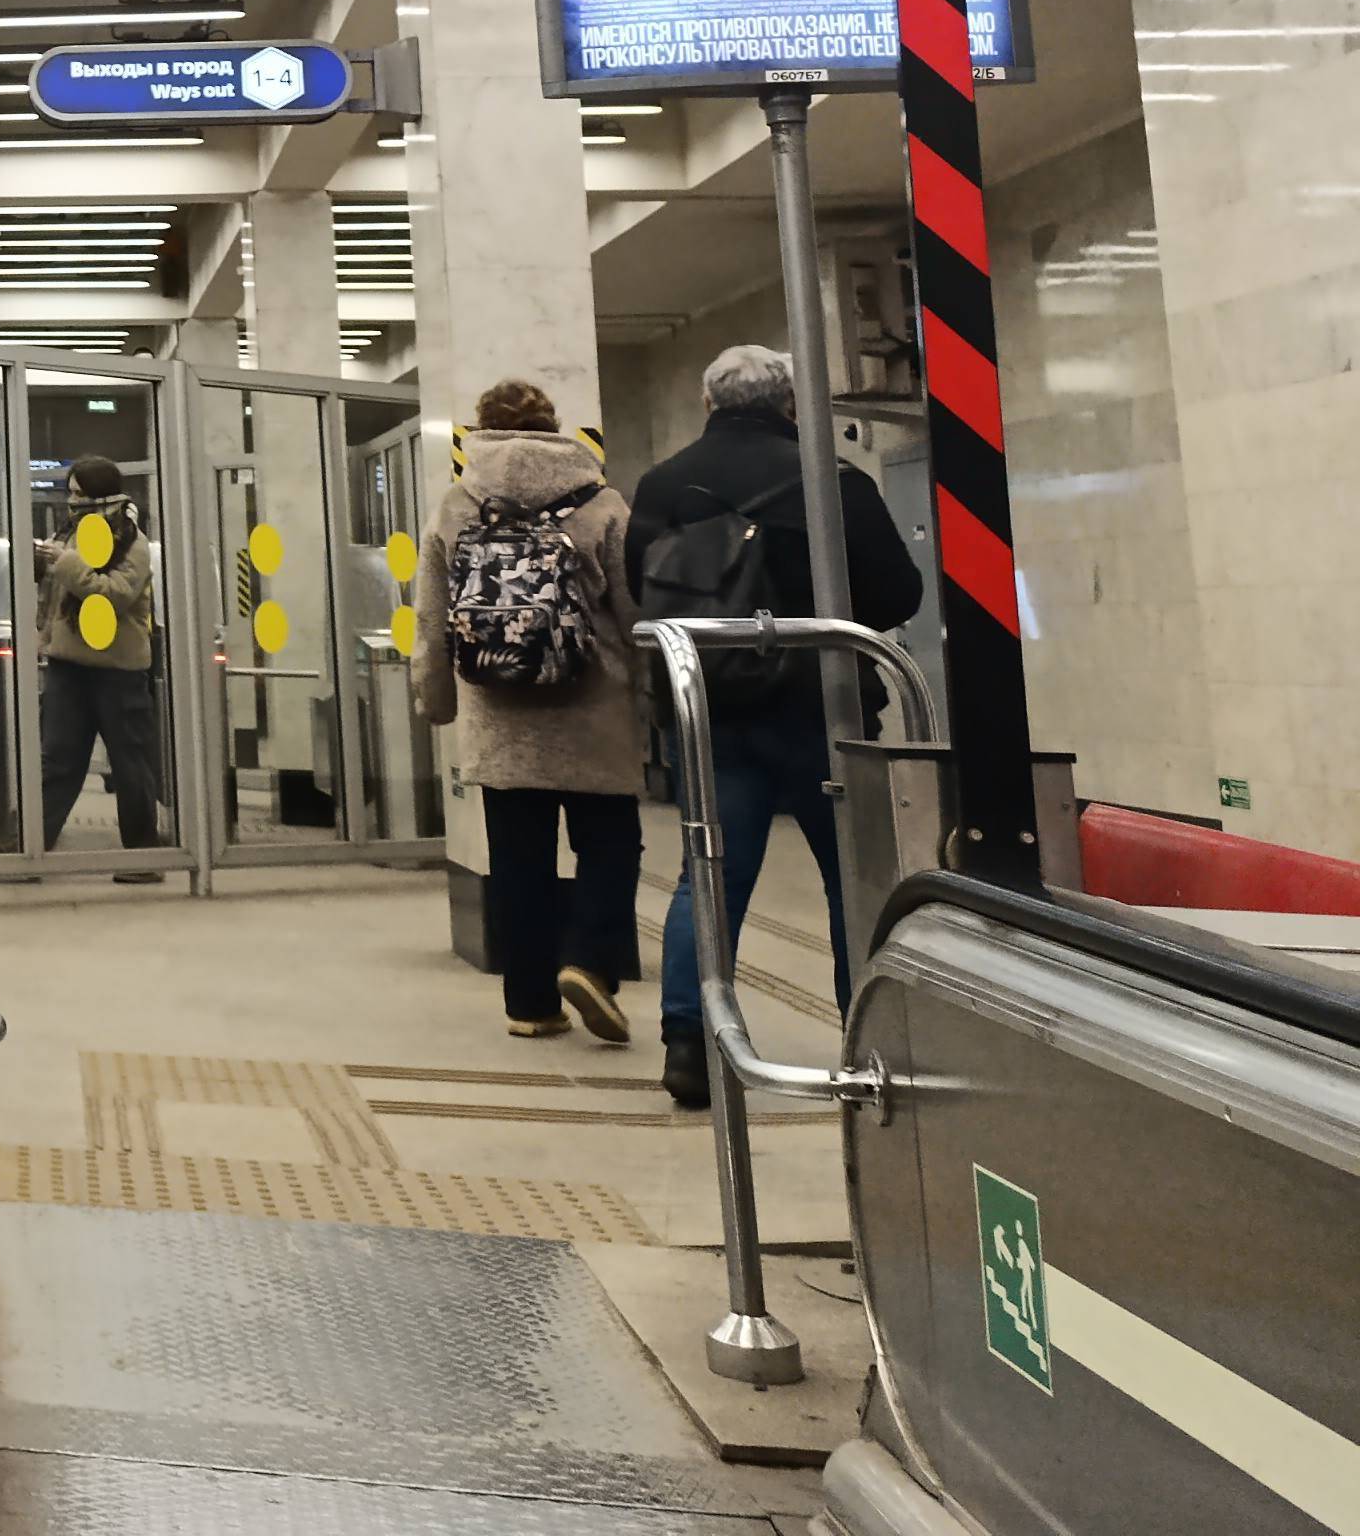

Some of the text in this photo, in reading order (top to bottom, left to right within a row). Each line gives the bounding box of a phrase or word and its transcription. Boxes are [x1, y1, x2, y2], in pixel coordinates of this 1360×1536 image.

[580, 21, 672, 48] ИМЕЮТСЯ
[674, 13, 871, 42] ПРОТИВОПОКАЗАНИЯ.
[582, 37, 819, 70] ПРОКОНСУЛЬТИРОВАТЬСЯ
[822, 36, 847, 57] СО
[69, 60, 235, 79] Выходы в город
[150, 83, 235, 102] Ways out
